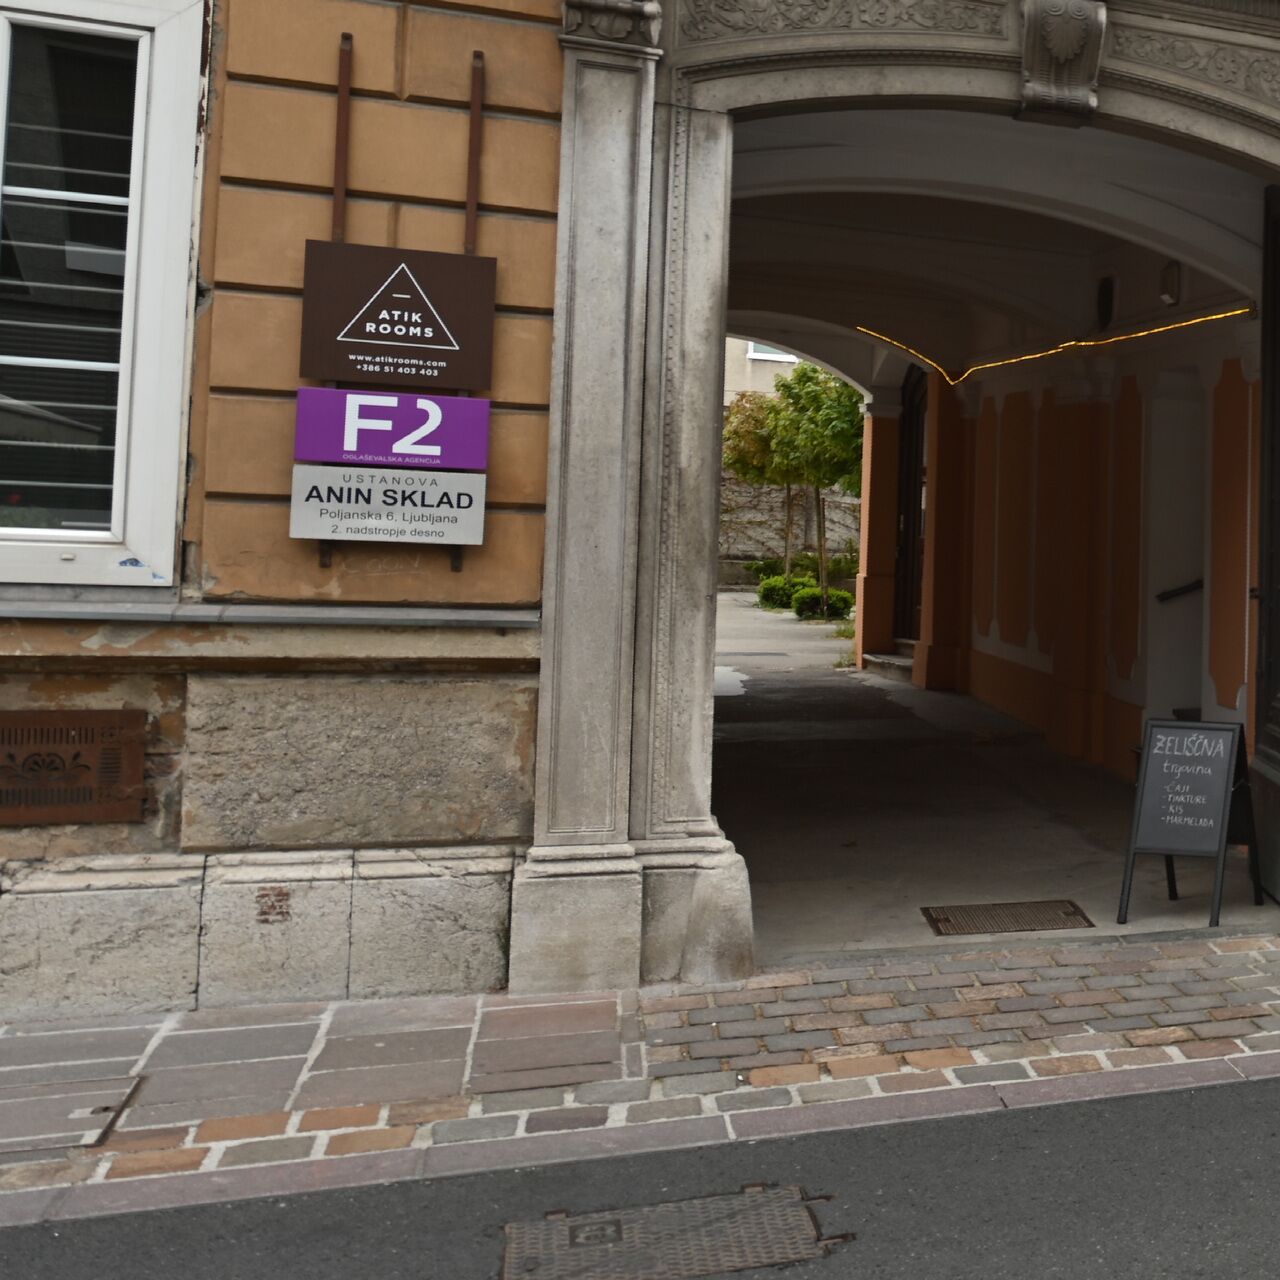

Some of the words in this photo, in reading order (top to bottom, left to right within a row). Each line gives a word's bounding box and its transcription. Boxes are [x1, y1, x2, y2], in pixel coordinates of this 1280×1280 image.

[378, 310, 422, 323] ATIK
[365, 322, 434, 338] ROOMS
[348, 354, 447, 368] www.atikrooms.com
[356, 363, 381, 372] +386
[397, 367, 416, 375] 403
[419, 368, 439, 377] 403
[343, 393, 443, 457] F2
[342, 453, 403, 464] OGLAŠEVALSKA
[403, 457, 441, 465] AGENCIJA
[342, 474, 439, 488] USTANOVA
[304, 485, 373, 505] ANIN
[381, 489, 474, 510] SKLAD
[319, 508, 383, 522] Poljanska
[402, 512, 459, 525] Ljubljana
[331, 524, 343, 535] 2.
[345, 526, 407, 539] nadstropje
[409, 528, 446, 539] desno
[1163, 760, 1212, 779] trgovina
